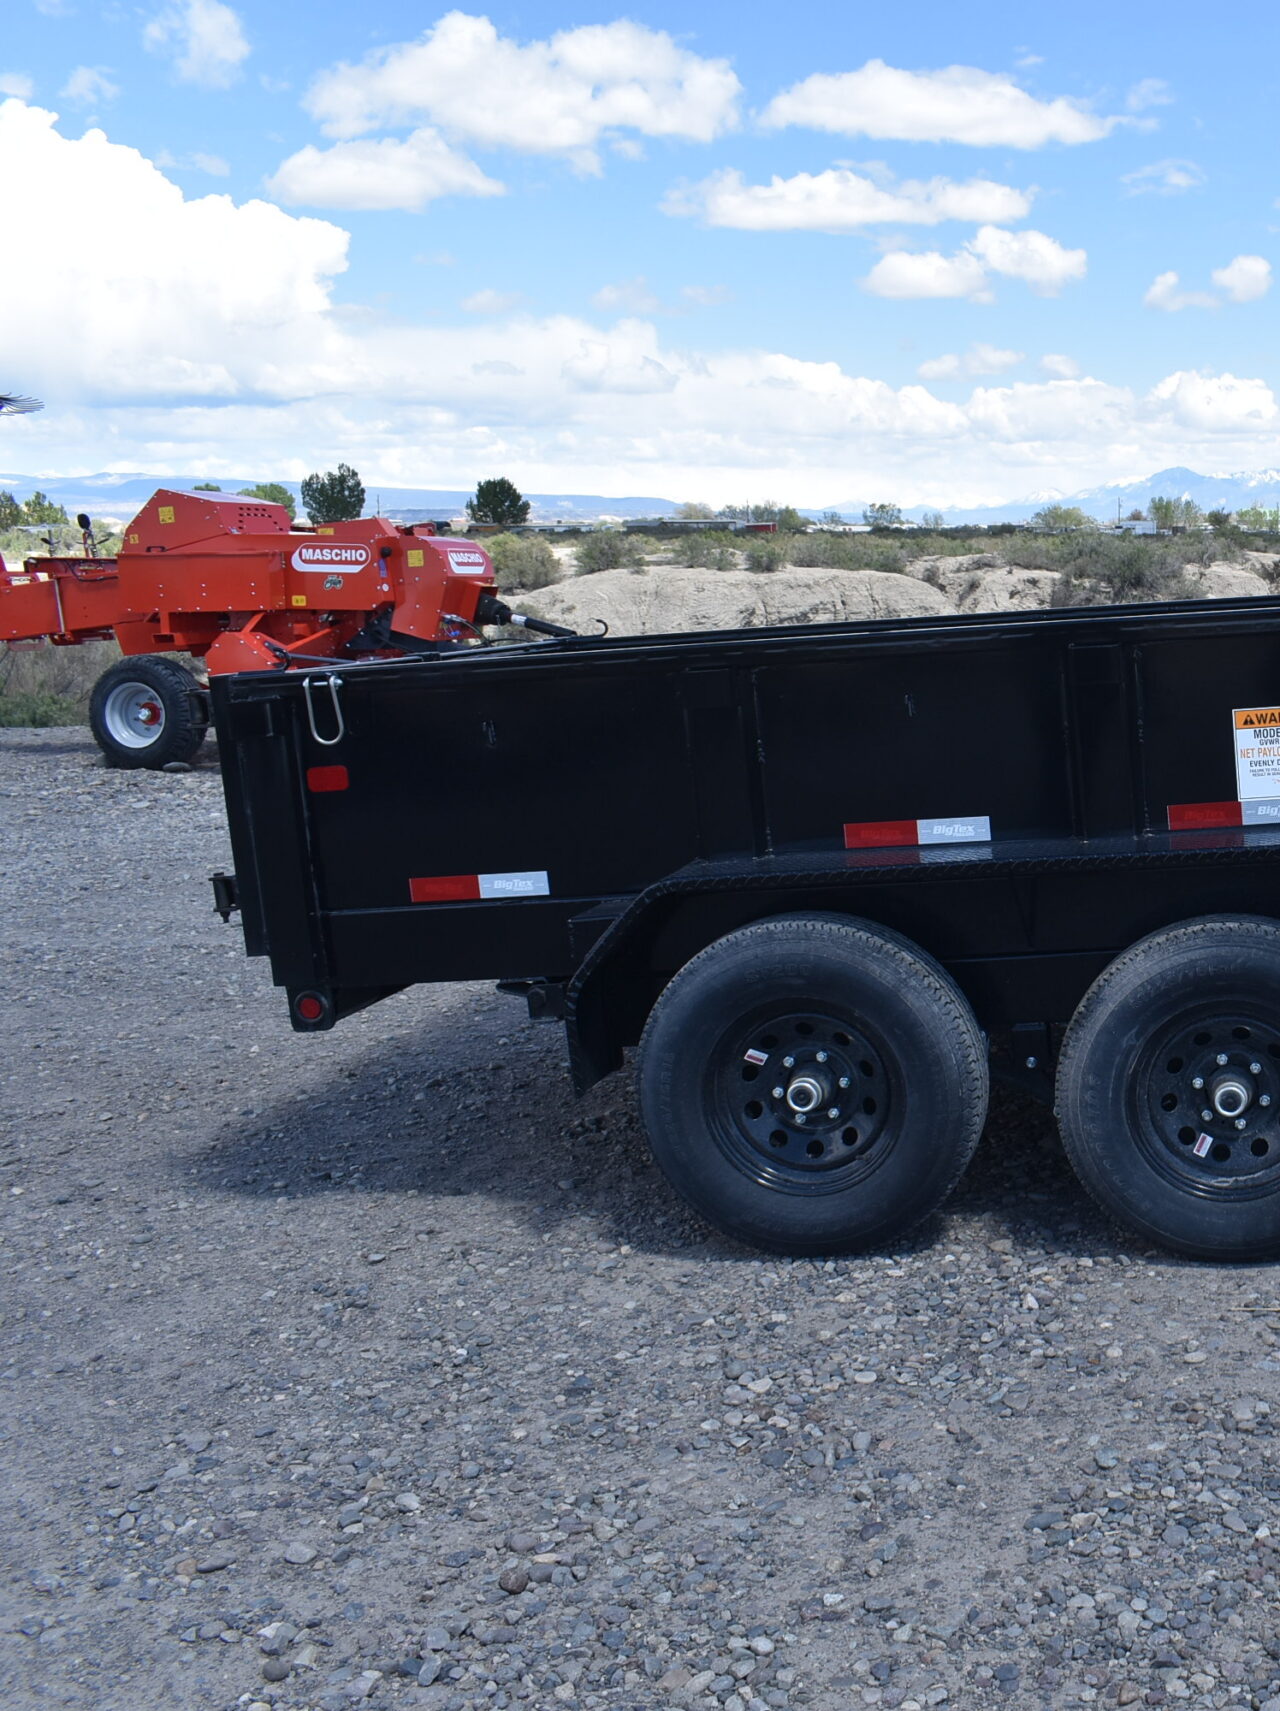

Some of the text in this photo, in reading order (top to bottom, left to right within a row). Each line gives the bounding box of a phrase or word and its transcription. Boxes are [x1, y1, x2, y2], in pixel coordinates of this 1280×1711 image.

[301, 548, 367, 562] MASCHIO
[450, 551, 484, 564] MASCHIO
[1259, 738, 1280, 746] GVWR
[1240, 748, 1256, 759] NET
[1249, 759, 1275, 768] EVENLY
[933, 823, 976, 836] BigTex
[494, 878, 535, 890] BigTex
